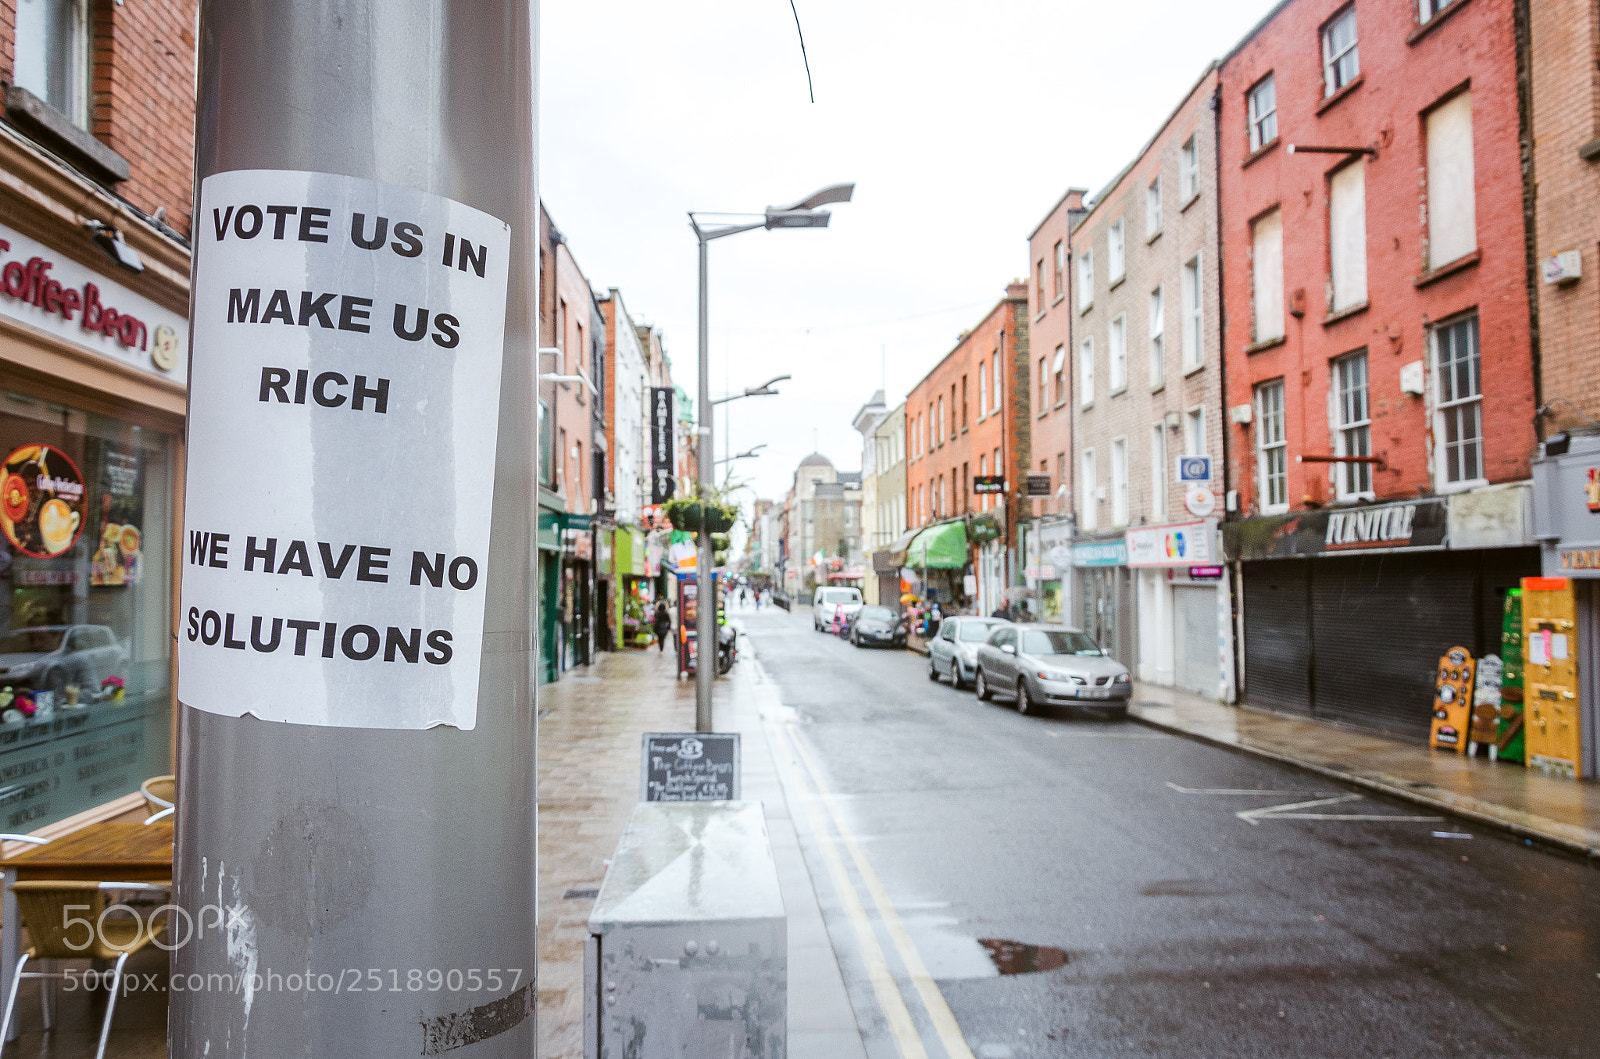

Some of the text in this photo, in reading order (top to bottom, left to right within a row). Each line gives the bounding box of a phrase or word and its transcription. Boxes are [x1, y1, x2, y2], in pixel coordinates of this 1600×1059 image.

[213, 205, 487, 278] VOTE US IN
[227, 288, 459, 349] MAKE US
[259, 367, 390, 414] RICH
[657, 390, 667, 462] RAMBLERS
[190, 530, 477, 591] WE HAVE NO
[187, 606, 453, 665] SOLUTIONS
